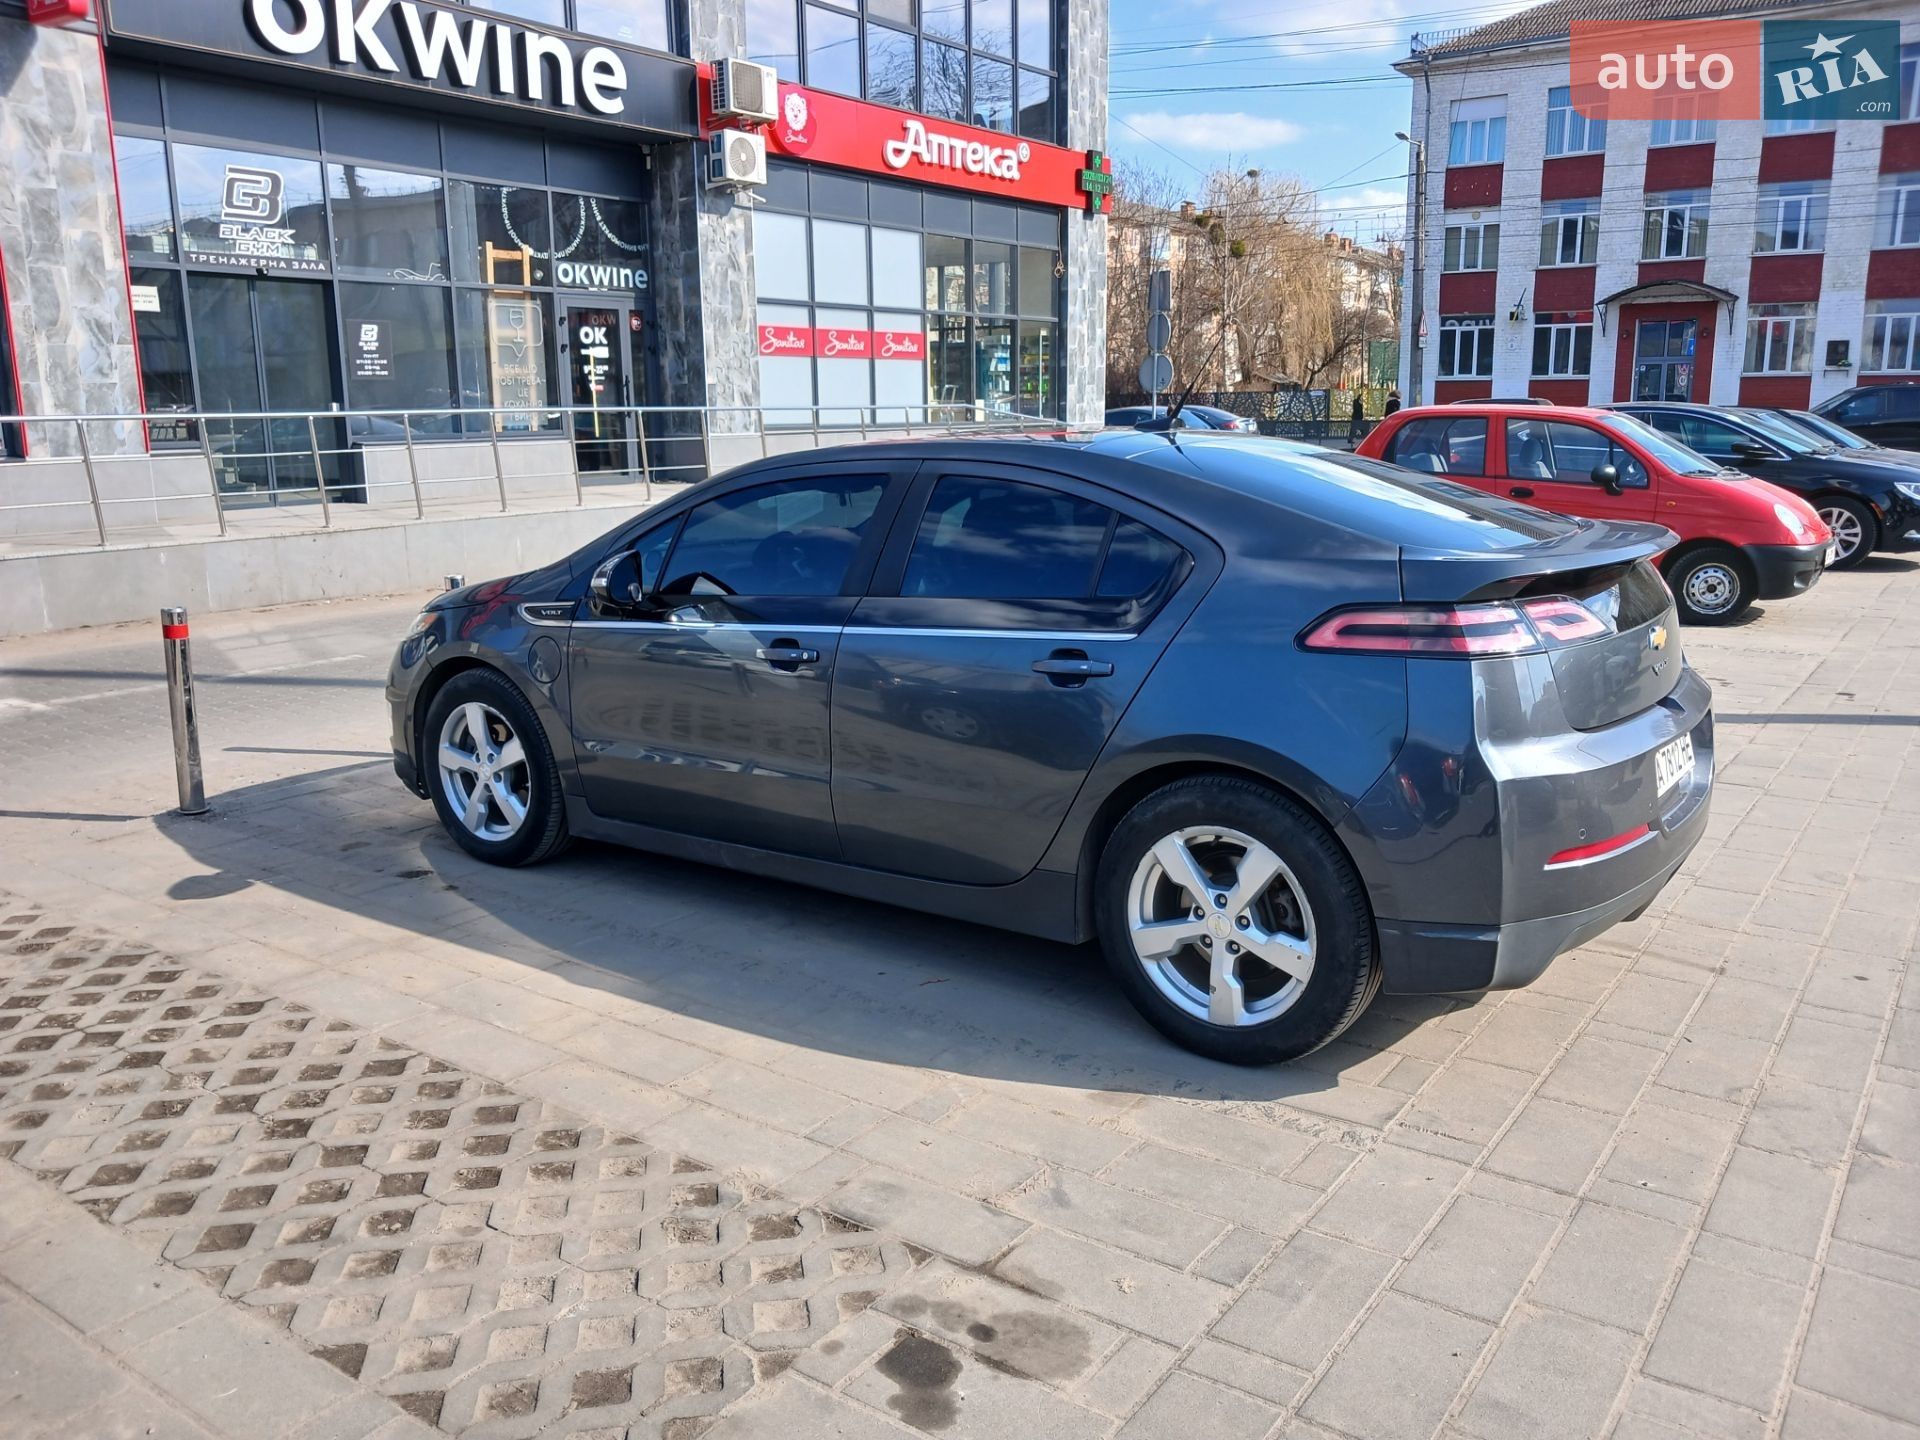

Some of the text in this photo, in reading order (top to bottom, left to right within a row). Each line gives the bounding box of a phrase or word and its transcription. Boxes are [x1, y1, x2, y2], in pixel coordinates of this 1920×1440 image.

[883, 119, 1020, 181] Аптека
[219, 224, 296, 244] BLACK
[235, 240, 282, 258] GYM
[190, 253, 326, 271] ТРЕНАЖЕРНА ЗАЛА
[579, 325, 608, 345] OK
[761, 327, 805, 353] Sanitas
[825, 330, 864, 356] Sanitas
[881, 333, 918, 357] Sanitas
